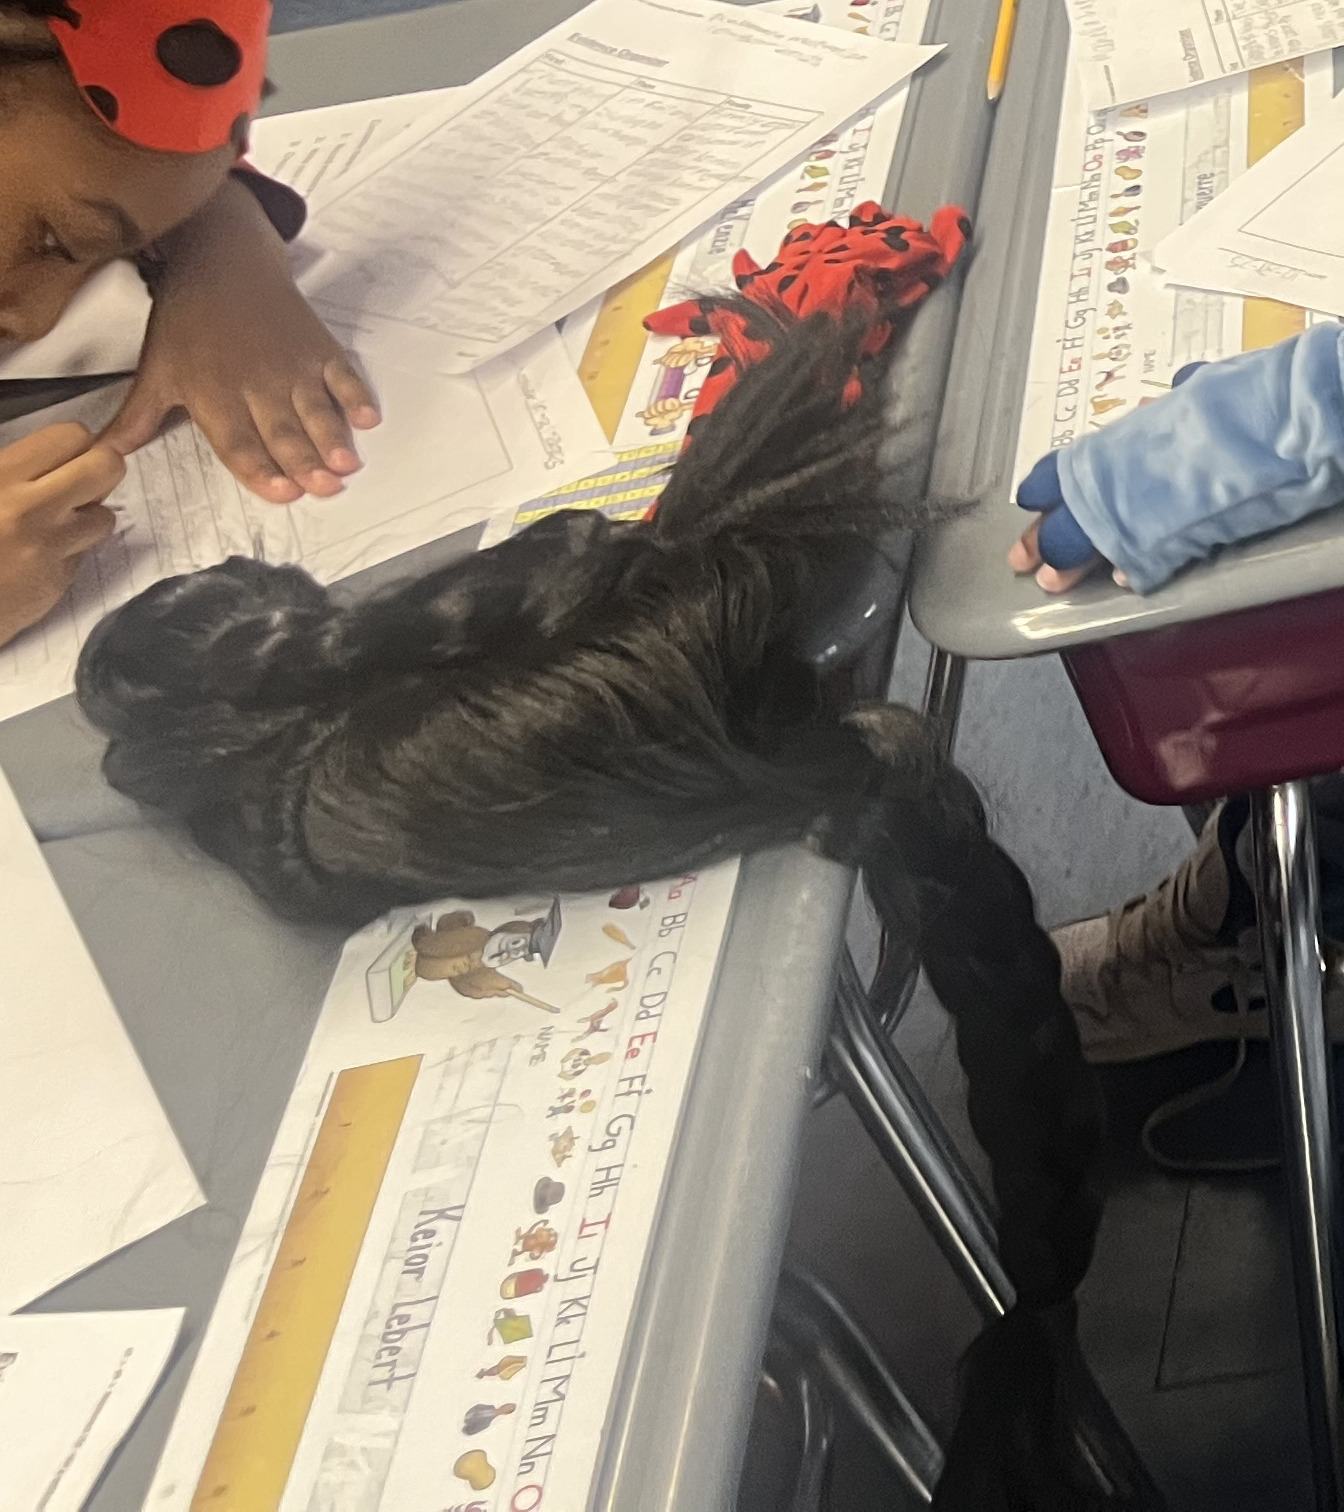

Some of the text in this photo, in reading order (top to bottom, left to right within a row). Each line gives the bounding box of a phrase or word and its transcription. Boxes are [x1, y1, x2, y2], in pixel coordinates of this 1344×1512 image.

[1084, 138, 1115, 152] Pp
[1083, 154, 1104, 172] Oo
[1067, 286, 1090, 305] Hh
[1064, 307, 1097, 330] Gg
[1059, 356, 1083, 375] Ee
[1055, 378, 1080, 398] Dd
[1053, 404, 1077, 423] Cc
[658, 911, 688, 939] Bb
[647, 950, 678, 978] Cc
[634, 991, 669, 1022] Dd
[624, 1030, 658, 1061] Ee
[587, 1113, 636, 1153] Gg
[588, 1163, 625, 1199] Hh
[553, 1256, 601, 1283] Jj
[554, 1294, 592, 1328] Kk
[528, 1374, 571, 1429] Mm
[516, 1433, 557, 1477] Nn
